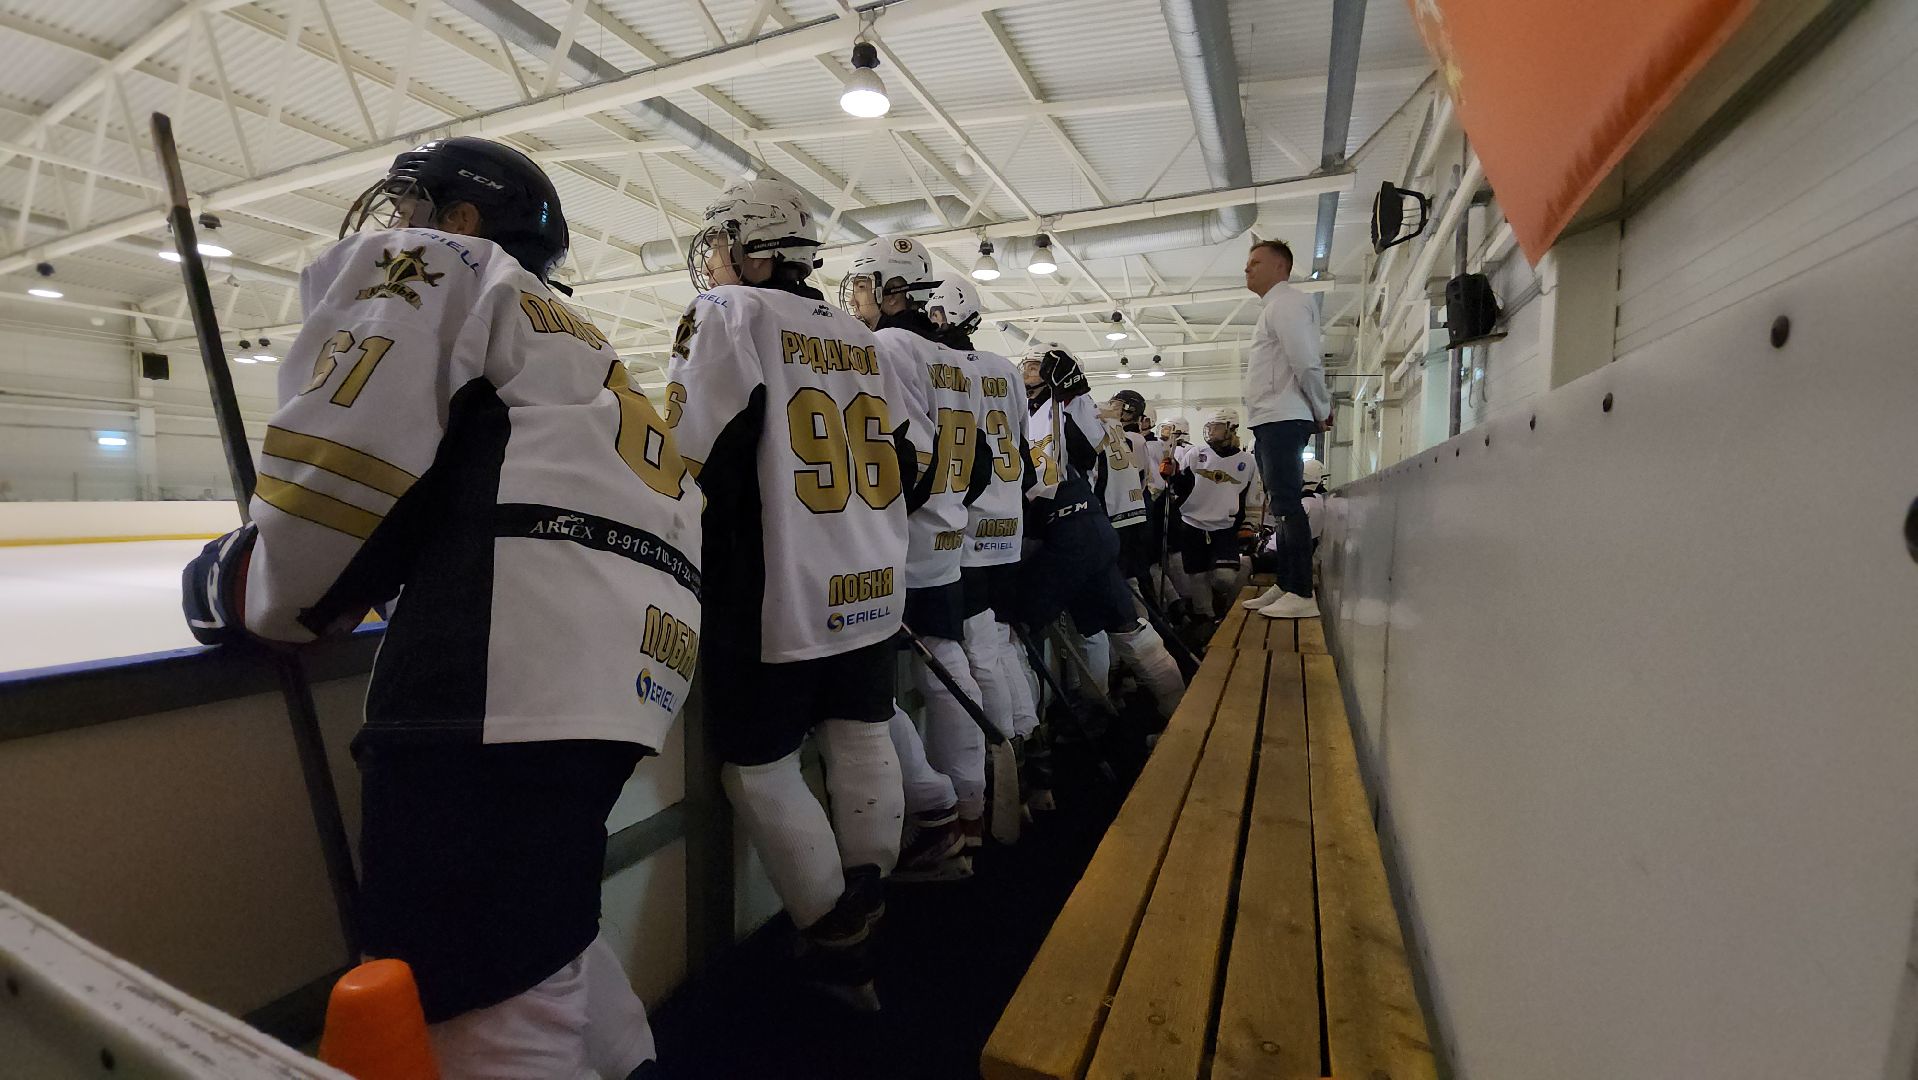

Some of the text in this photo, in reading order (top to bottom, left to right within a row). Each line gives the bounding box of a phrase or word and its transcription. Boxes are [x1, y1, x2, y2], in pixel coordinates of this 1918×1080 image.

[457, 168, 505, 191] CCM
[980, 376, 1008, 398] КОВ
[601, 359, 687, 502] 6
[786, 386, 902, 514] 96
[986, 409, 1022, 482] 3
[975, 518, 1019, 537] ЛОБНЯ
[934, 529, 965, 551] ЛОБ
[983, 541, 1013, 551] ERIELL
[828, 566, 894, 607] ЛОБНЯ
[846, 605, 891, 625] ERIELL
[640, 604, 698, 682] ЛОБН
